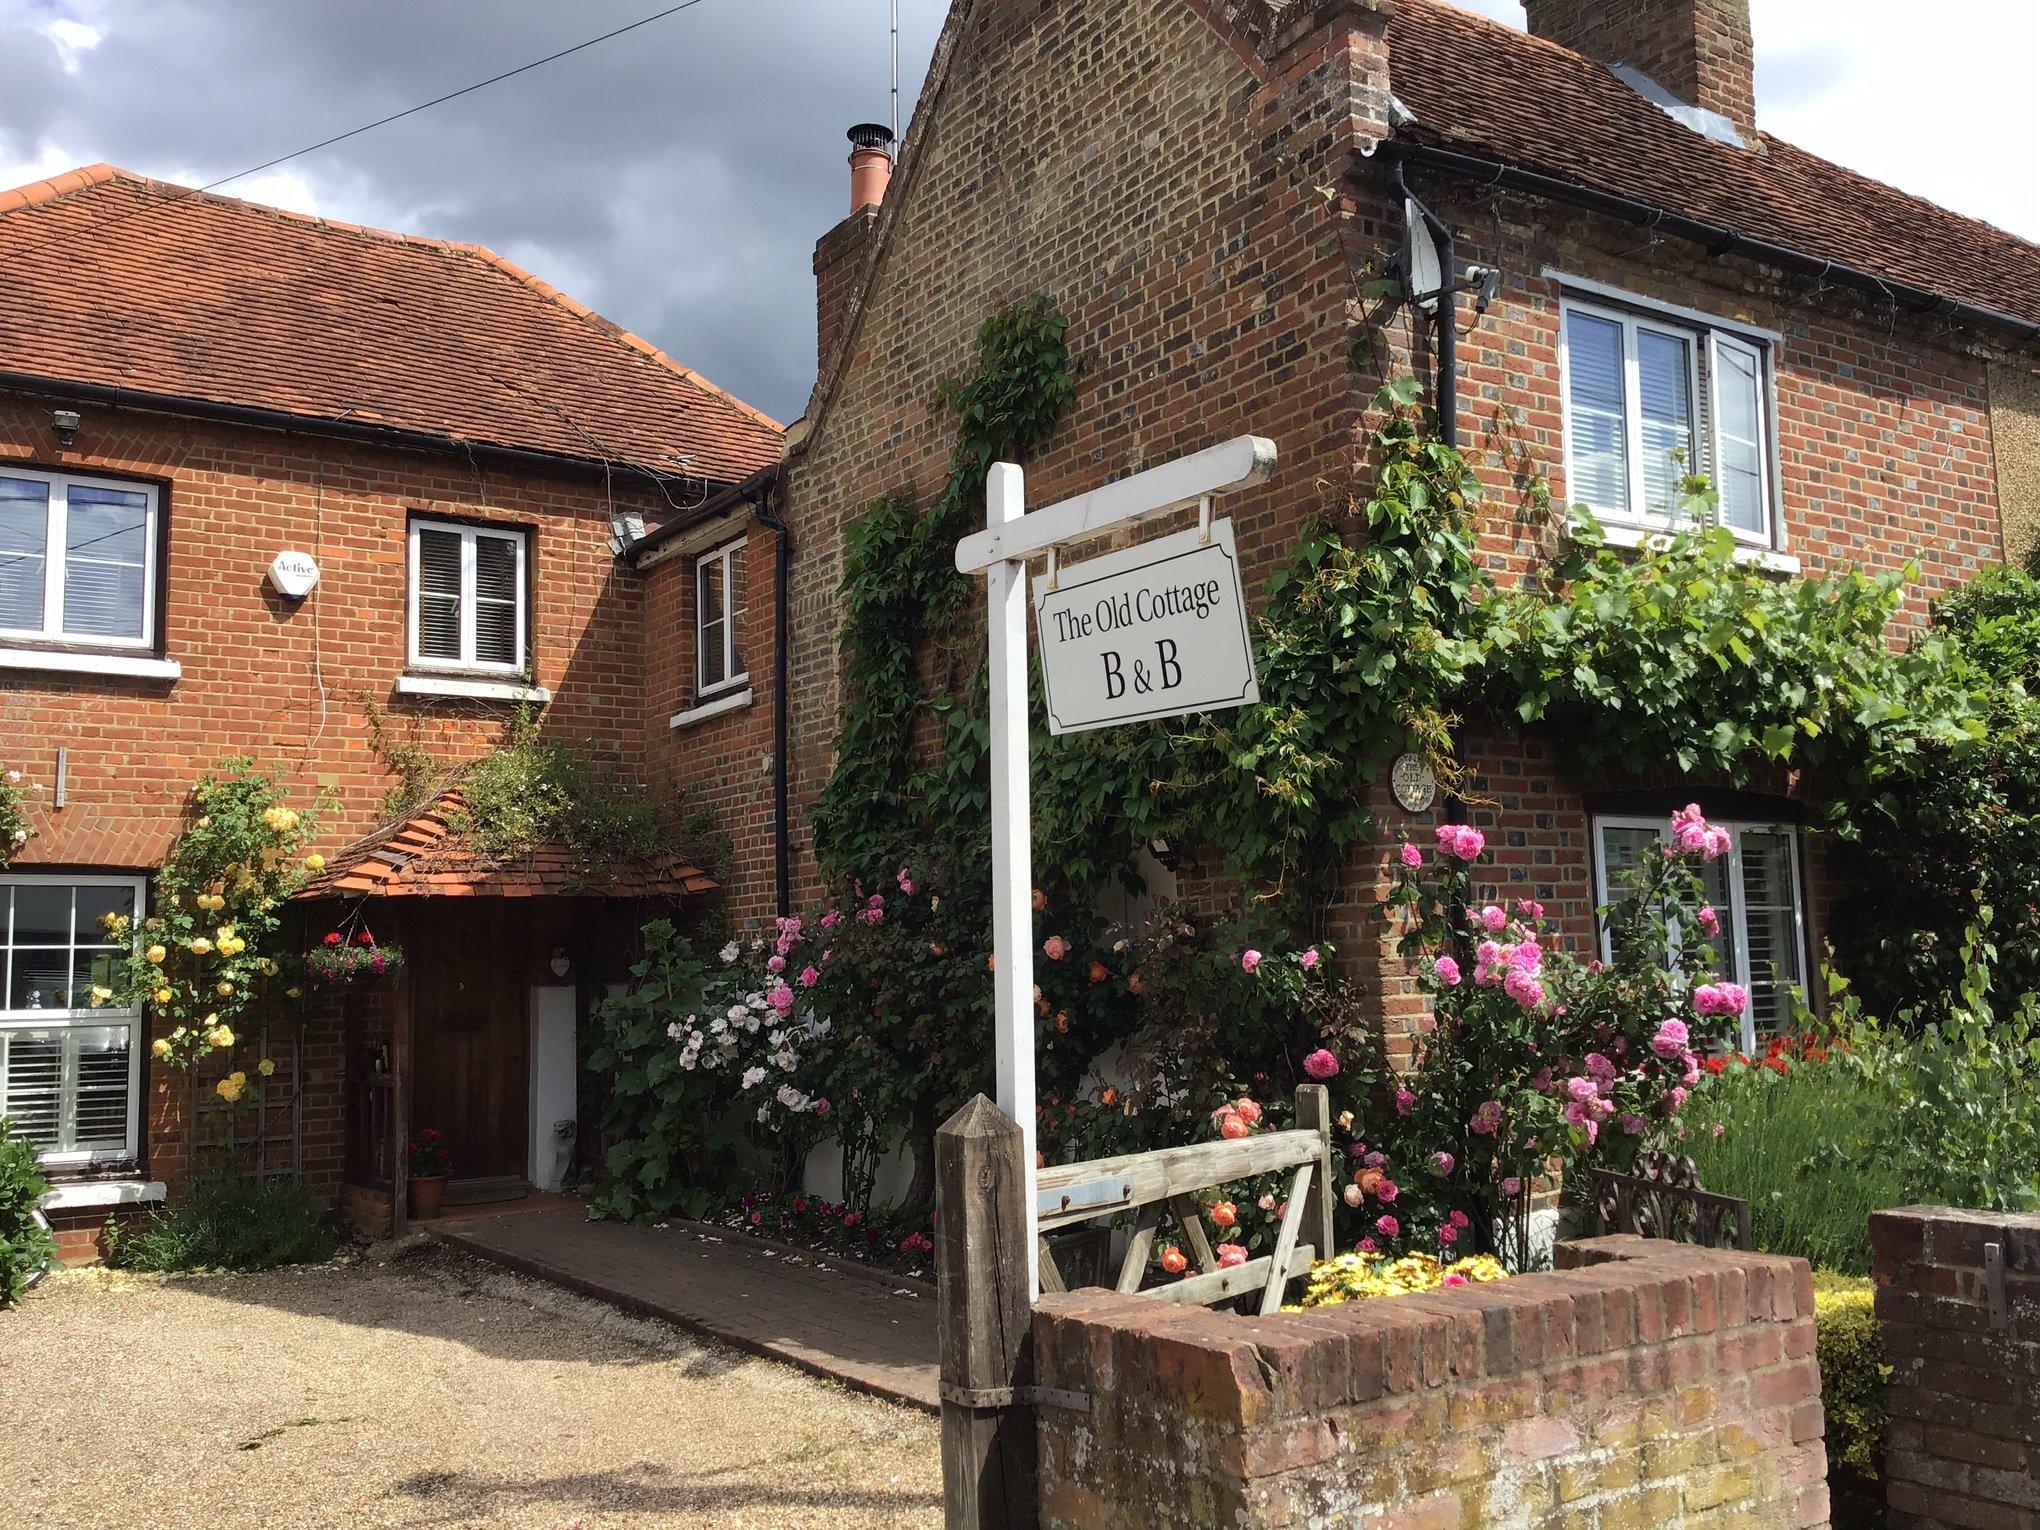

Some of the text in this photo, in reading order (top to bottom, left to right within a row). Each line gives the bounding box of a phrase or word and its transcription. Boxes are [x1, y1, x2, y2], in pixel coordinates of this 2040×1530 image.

[278, 561, 313, 574] Active
[1053, 580, 1221, 643] The Old Cottage
[1100, 638, 1182, 700] B & B
[1402, 773, 1421, 781] OLD
